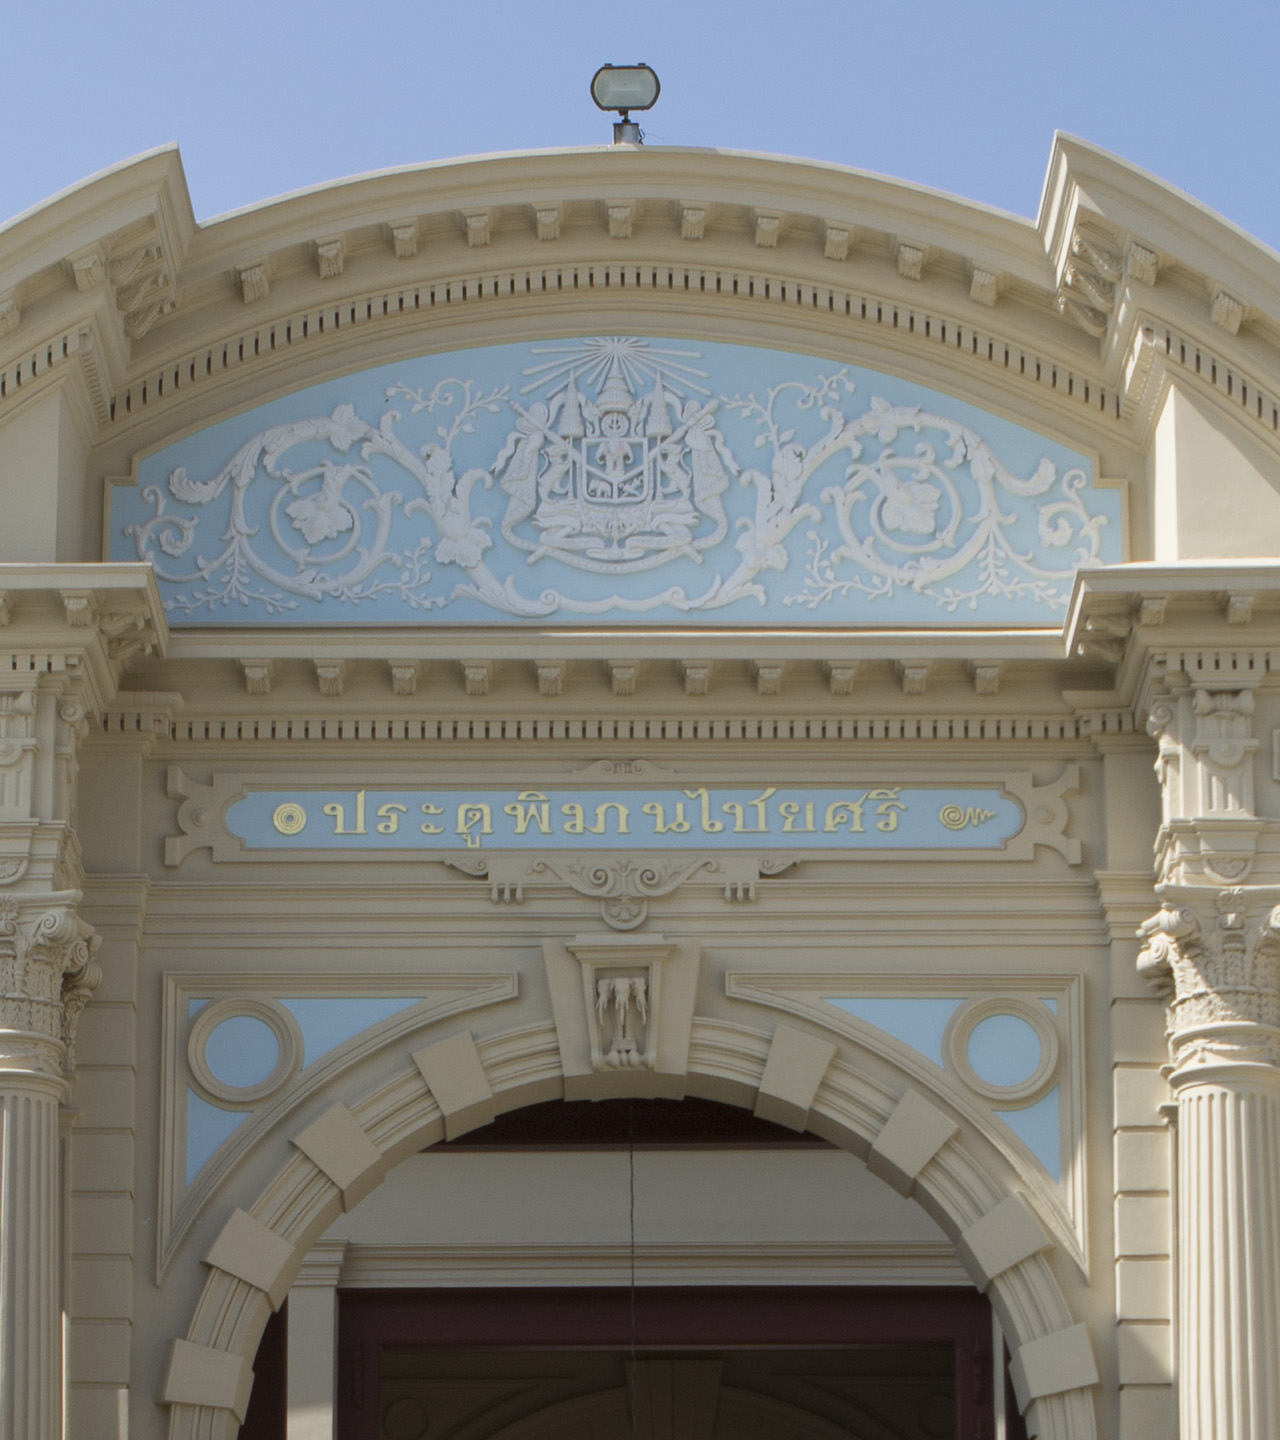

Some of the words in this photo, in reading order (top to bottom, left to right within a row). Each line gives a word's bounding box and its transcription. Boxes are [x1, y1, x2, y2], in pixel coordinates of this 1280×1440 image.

[323, 787, 908, 849] ประตูพิมานไชยศรี
